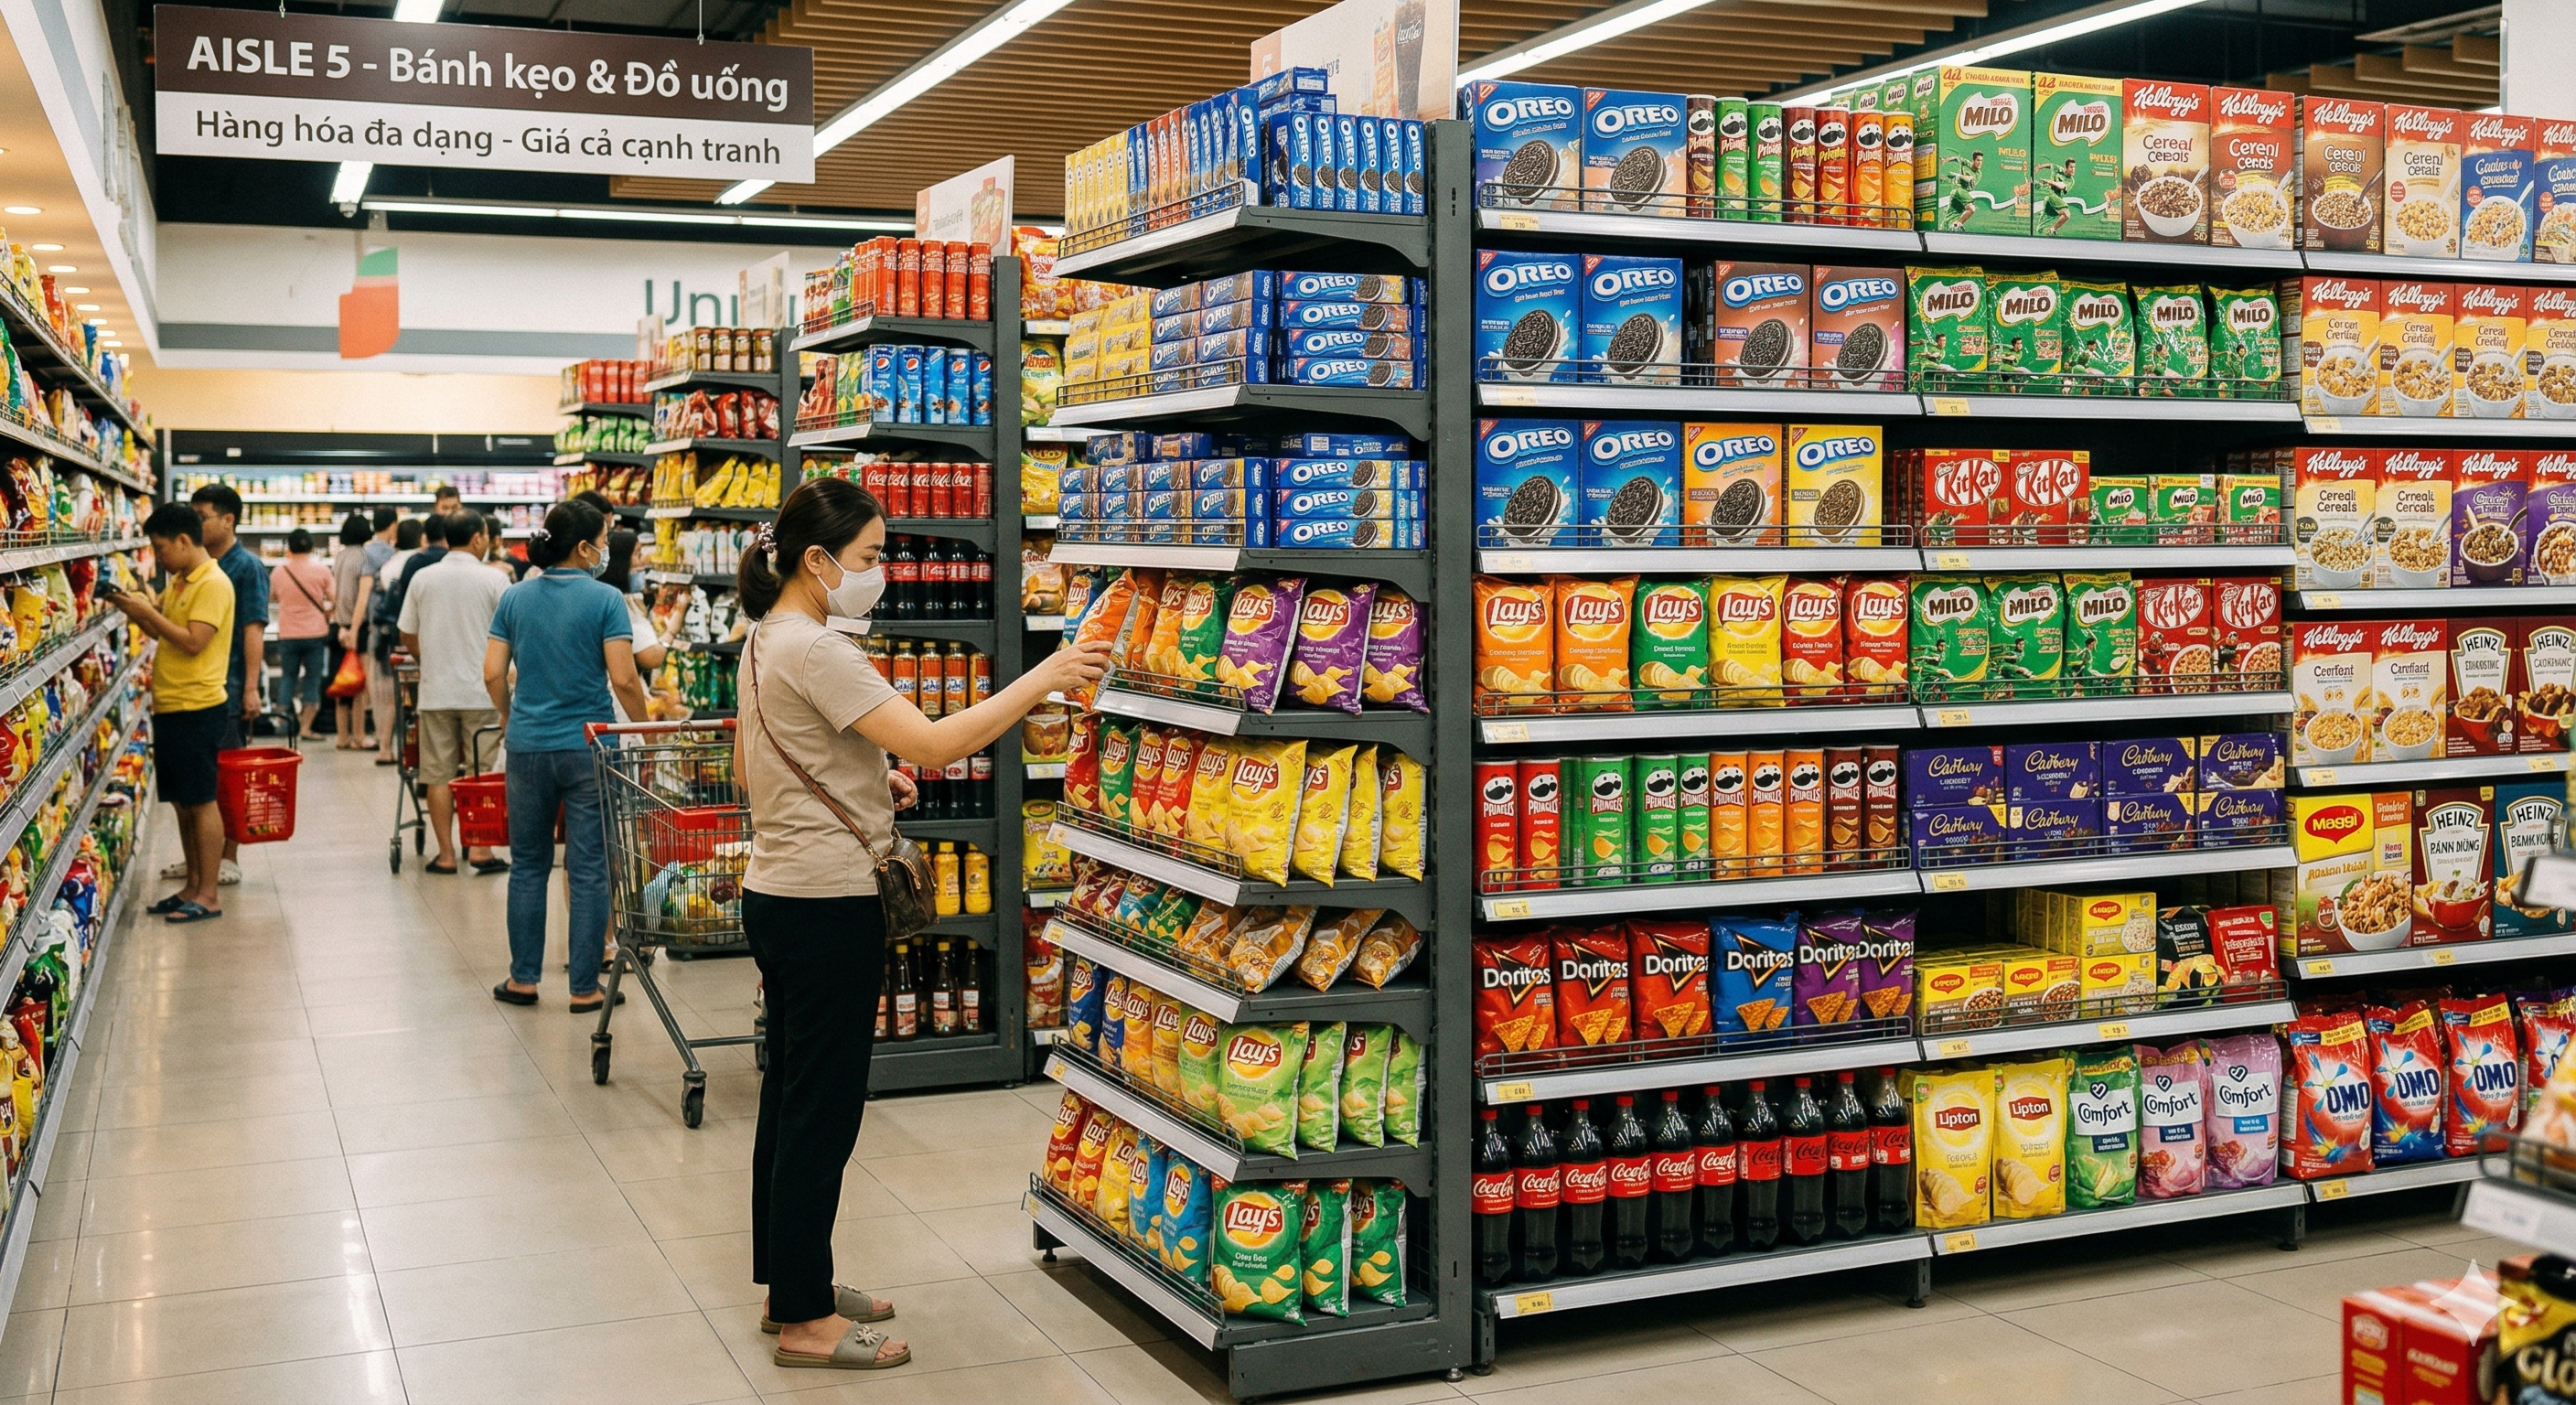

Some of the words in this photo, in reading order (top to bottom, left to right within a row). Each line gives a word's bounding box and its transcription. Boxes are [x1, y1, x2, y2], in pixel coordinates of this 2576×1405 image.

[187, 35, 315, 78] AISLE
[326, 44, 351, 79] 5
[390, 47, 492, 87] Bánh
[505, 52, 576, 100] kẹo
[586, 59, 617, 94] &
[624, 59, 681, 98] Đồ
[691, 63, 789, 113] uống
[1487, 98, 1573, 126] OREO
[1595, 106, 1679, 134] OREO
[1963, 106, 2013, 126] MILO
[2058, 113, 2106, 134] MILO
[197, 110, 284, 147] Hàng
[295, 113, 354, 145] hóa
[364, 118, 402, 146] đa
[413, 121, 493, 157] dạng
[521, 127, 570, 155] Giá
[580, 128, 613, 156] cả
[622, 133, 693, 166] cạnh
[702, 137, 780, 165] tranh
[2543, 123, 2576, 152] Kello
[1299, 275, 1357, 295] OREO
[1487, 264, 1572, 292] OREO
[1594, 269, 1675, 296] OREO
[1725, 275, 1803, 303] OREO
[1822, 280, 1897, 306] OREO
[1927, 292, 1975, 312] MILO
[1302, 304, 1360, 324] OREO
[2004, 296, 2051, 316] MILO
[2078, 302, 2120, 320] MILO
[2156, 306, 2195, 321] MILO
[2233, 308, 2270, 323] MILO
[1305, 332, 1364, 351] OREO
[1309, 360, 1368, 380] OREO
[1488, 429, 1572, 459] OREO
[1593, 431, 1673, 460] OREO
[1696, 437, 1775, 466] OREO
[1799, 437, 1874, 467] OREO
[1293, 462, 1348, 482] OREO
[1943, 459, 1997, 504] KitKat
[2024, 459, 2077, 504] KitKat
[1293, 490, 1348, 511] OREO
[2317, 501, 2357, 513] Cereals
[1293, 520, 1348, 542] OREO
[1928, 596, 1974, 616] MILO
[2009, 595, 2053, 617] MILO
[2083, 597, 2126, 617] MILO
[2465, 635, 2498, 651] HEINZ
[2536, 632, 2570, 650] HEINZ
[2313, 812, 2358, 831] Maggi
[2435, 810, 2474, 830] HEINZ
[2516, 805, 2554, 823] HEINZ
[1562, 959, 1628, 981] Doritos
[1727, 949, 1794, 971] Doritos
[1483, 966, 1551, 989] Doritos
[2395, 1068, 2441, 1099] OMO
[2473, 1061, 2517, 1092] OMO
[2143, 1092, 2199, 1117] Comfort
[2218, 1082, 2273, 1108] Comfort
[2325, 1081, 2371, 1114] OMO
[2012, 1101, 2049, 1117] Lipton
[2077, 1099, 2131, 1126] Comfort
